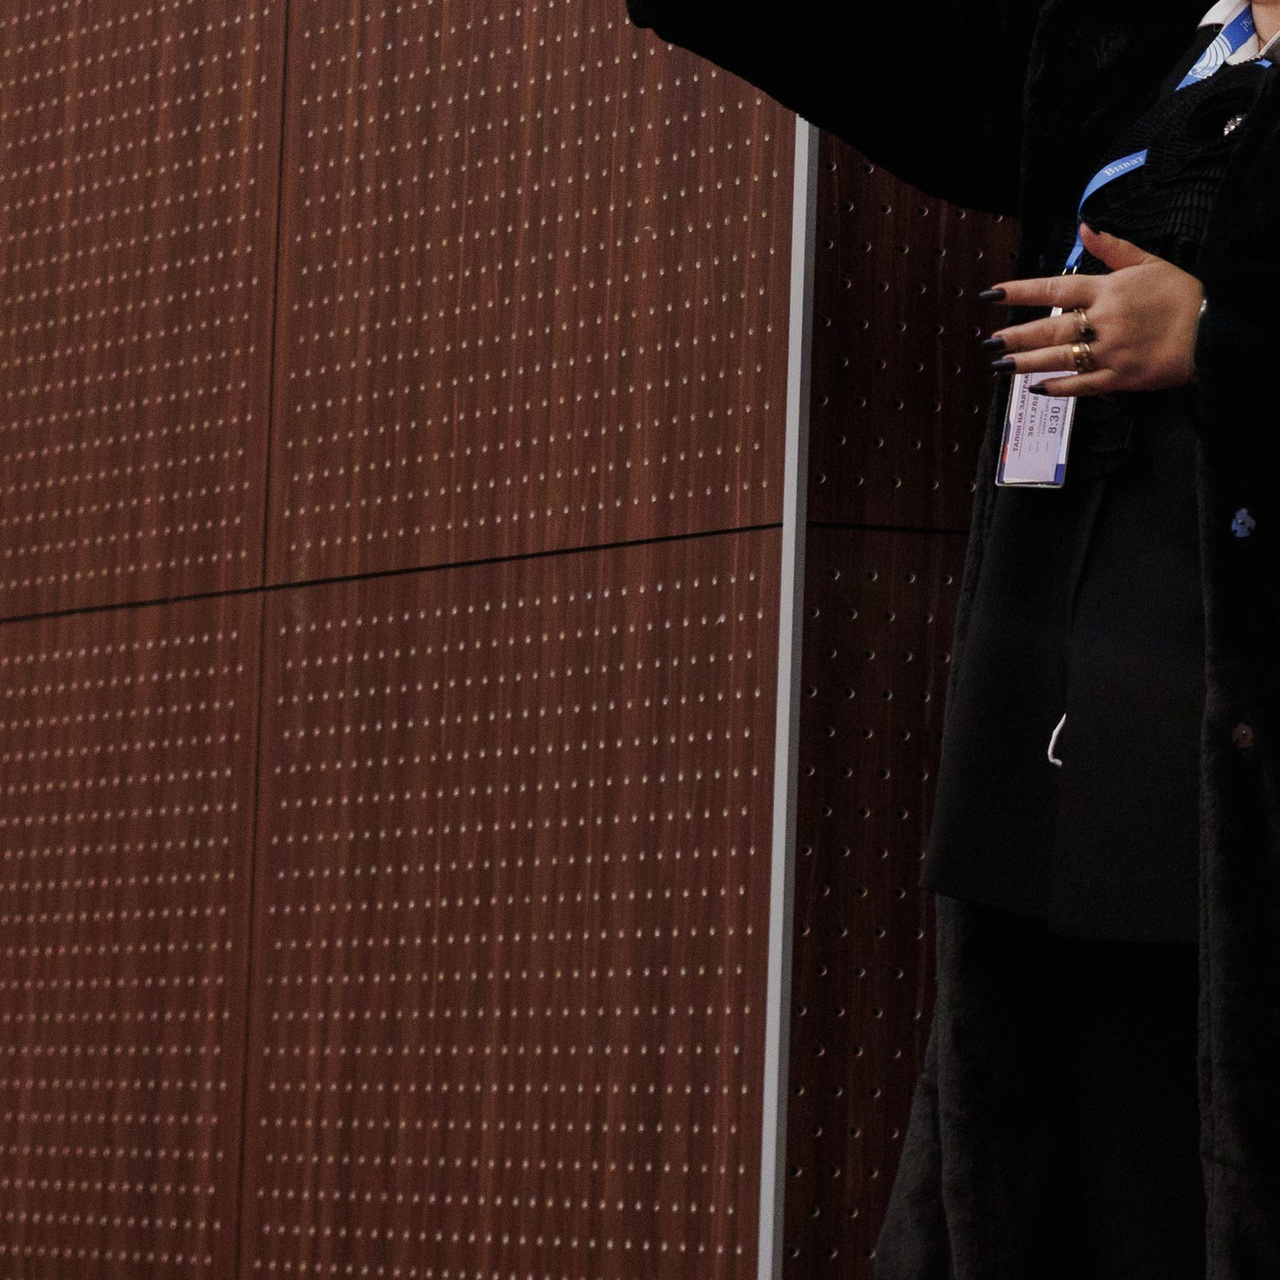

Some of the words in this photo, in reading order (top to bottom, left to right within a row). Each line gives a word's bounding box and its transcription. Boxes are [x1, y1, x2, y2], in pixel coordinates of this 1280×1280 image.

[1017, 412, 1024, 423] НА
[1028, 393, 1039, 437] 30.11.202
[1048, 406, 1061, 434] 8:30
[1013, 425, 1022, 452] ТАЛОН
